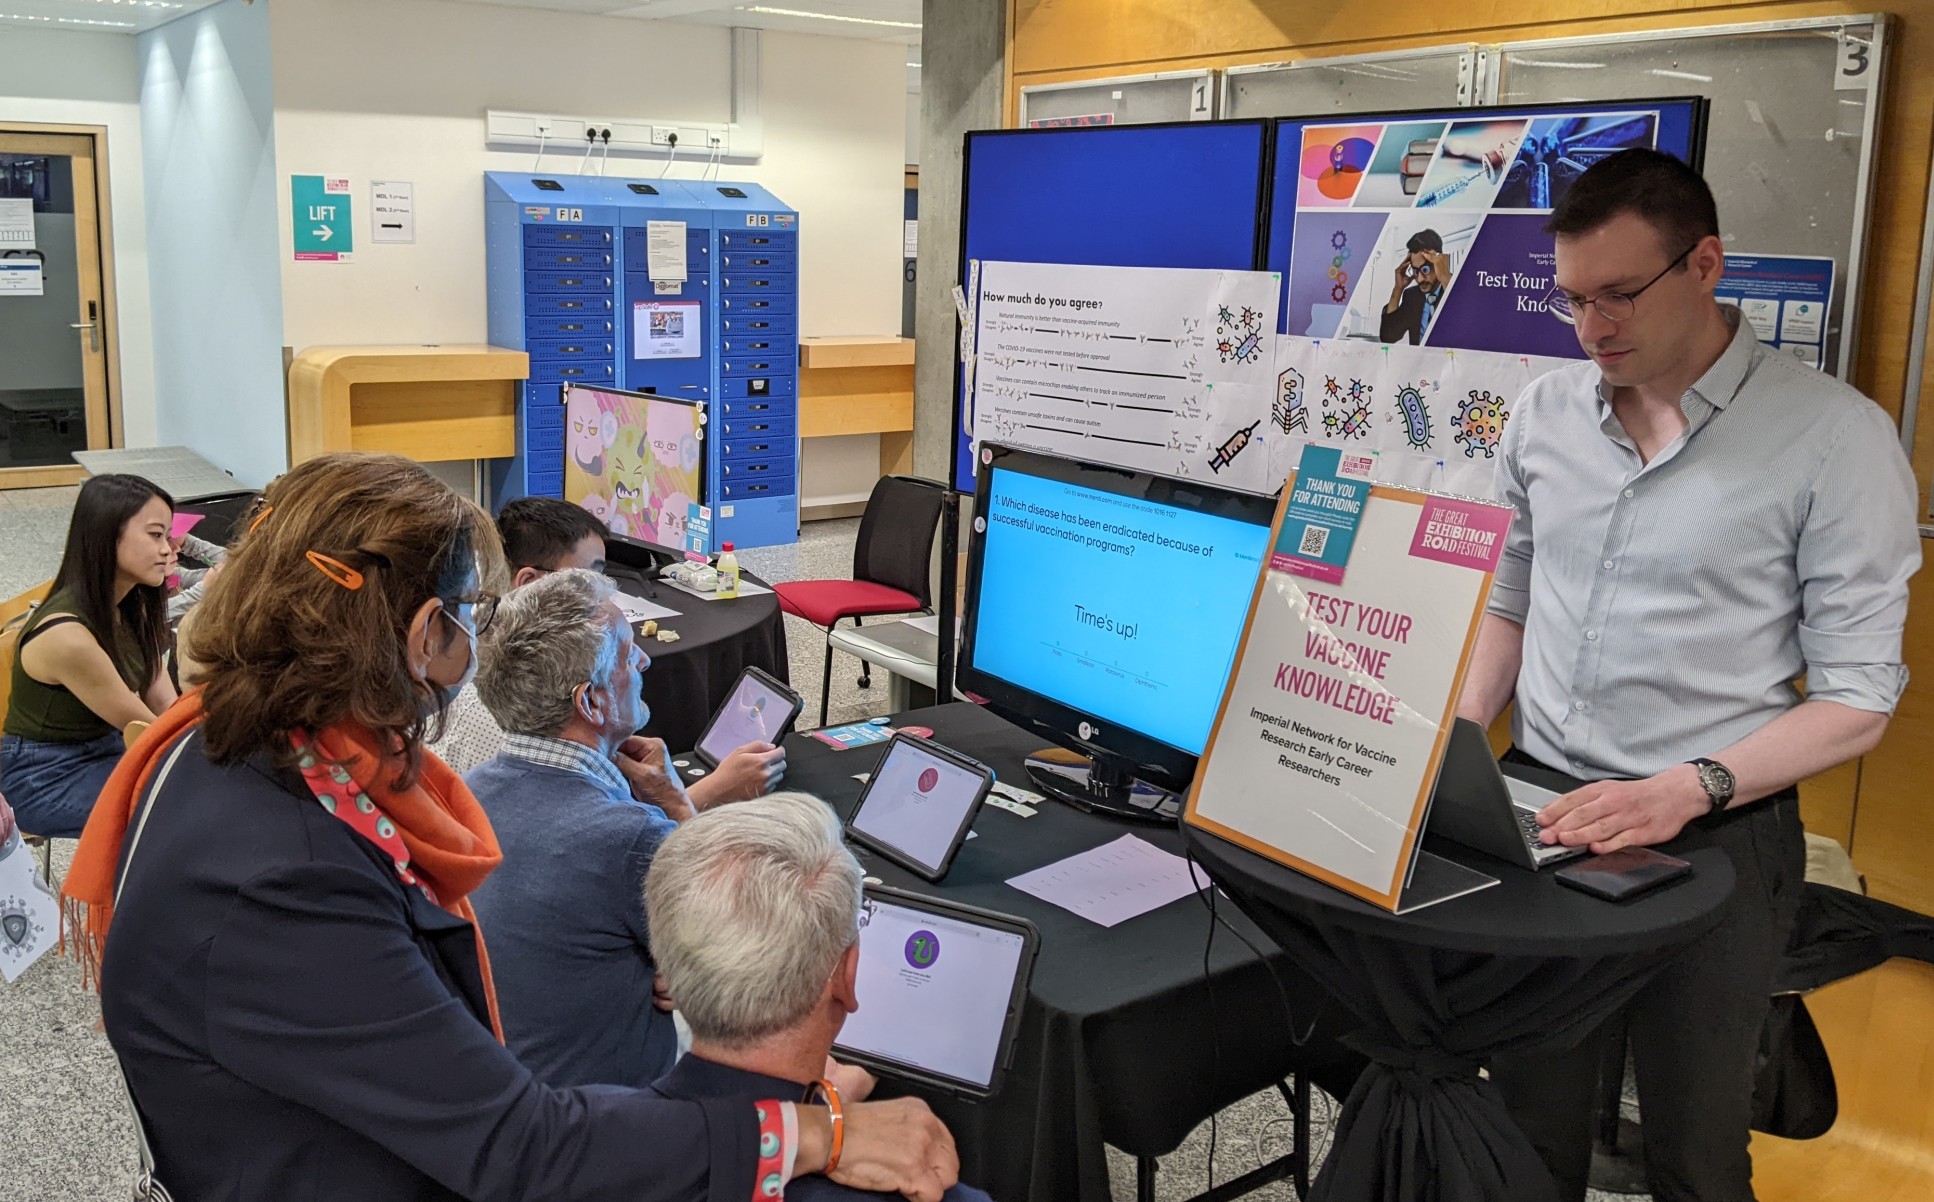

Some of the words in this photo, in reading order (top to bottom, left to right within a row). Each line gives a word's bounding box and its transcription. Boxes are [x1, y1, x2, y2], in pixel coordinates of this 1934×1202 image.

[1842, 41, 1869, 76] 3
[1195, 86, 1207, 112] 1
[309, 205, 336, 221] LIFT
[560, 210, 565, 219] F
[573, 210, 580, 220] A
[750, 216, 754, 225] F
[760, 216, 766, 225] B
[1476, 271, 1508, 287] Test
[1512, 272, 1548, 290] Your
[984, 291, 1004, 302] How
[1008, 292, 1032, 304] much
[1034, 293, 1046, 305] do
[1049, 298, 1066, 308] you
[1070, 300, 1102, 310] agree?
[1062, 318, 1097, 326] vaccine-acquired
[1098, 320, 1120, 328] immunity
[1076, 352, 1090, 360] before
[1038, 380, 1060, 389] microchips
[1061, 383, 1079, 391] enabling
[1306, 478, 1335, 495] THANK
[1337, 483, 1356, 498] YOU
[1140, 505, 1153, 514] code
[1154, 508, 1165, 516] 1016
[1292, 490, 1310, 503] FOR
[1310, 494, 1360, 514] ATTENDING
[994, 494, 1000, 505] 1.
[1002, 496, 1026, 512] Which
[1028, 503, 1059, 520] disease
[1061, 510, 1076, 524] has
[1078, 515, 1100, 530] been
[1103, 524, 1154, 543] eradicated
[1156, 533, 1200, 554] because
[1202, 546, 1214, 557] of
[1431, 508, 1446, 522] THE
[1444, 510, 1469, 526] GREAT
[992, 512, 1035, 531] successful
[1035, 523, 1085, 544] vaccination
[1086, 537, 1135, 557] programs?
[1426, 520, 1497, 546] EXHIBITION
[1421, 534, 1457, 552] ROAD
[1456, 541, 1491, 560] FESTIVAL
[1074, 604, 1113, 632] Time's
[1116, 623, 1138, 640] up!
[1305, 592, 1354, 627] TEST
[1357, 604, 1412, 644] YOUR
[1305, 631, 1391, 680] VACCINE
[1274, 662, 1396, 725] KNOWLEDGE
[1091, 726, 1099, 736] LG
[1250, 706, 1290, 729] Imperial
[1292, 721, 1335, 745] Network
[1337, 737, 1352, 750] for
[1355, 742, 1397, 766] Vaccine
[1260, 729, 1306, 754] Research
[1308, 746, 1335, 766] Early
[1337, 757, 1373, 778] Career
[1278, 754, 1341, 786] Researchers
